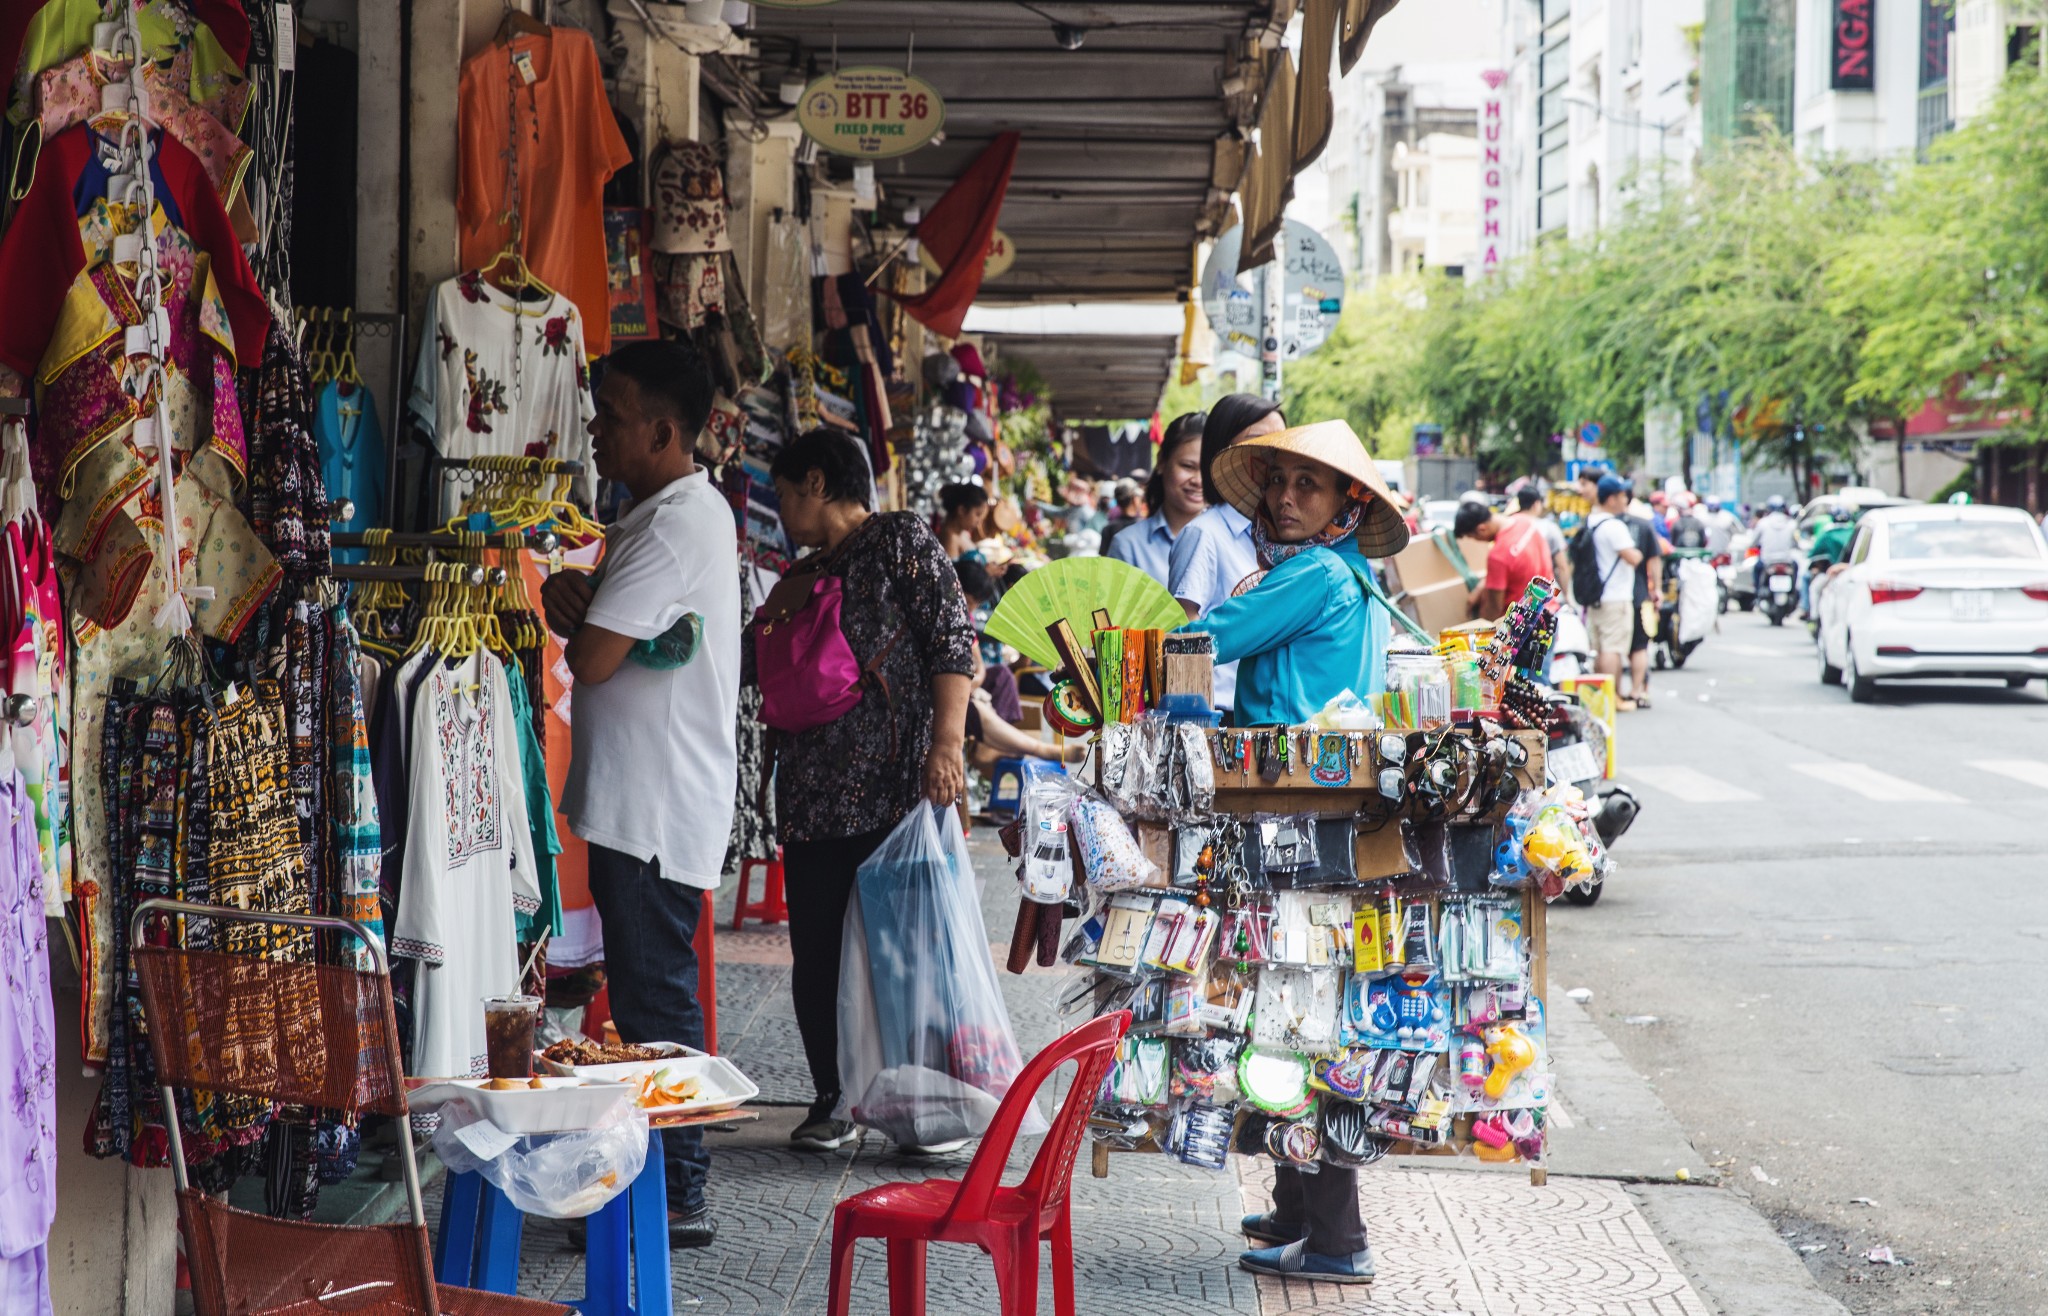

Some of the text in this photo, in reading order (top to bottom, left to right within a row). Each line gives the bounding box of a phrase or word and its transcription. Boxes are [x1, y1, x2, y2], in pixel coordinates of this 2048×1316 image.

[846, 92, 891, 119] BTT
[899, 93, 928, 119] 36
[834, 124, 905, 135] FIXED PRICE
